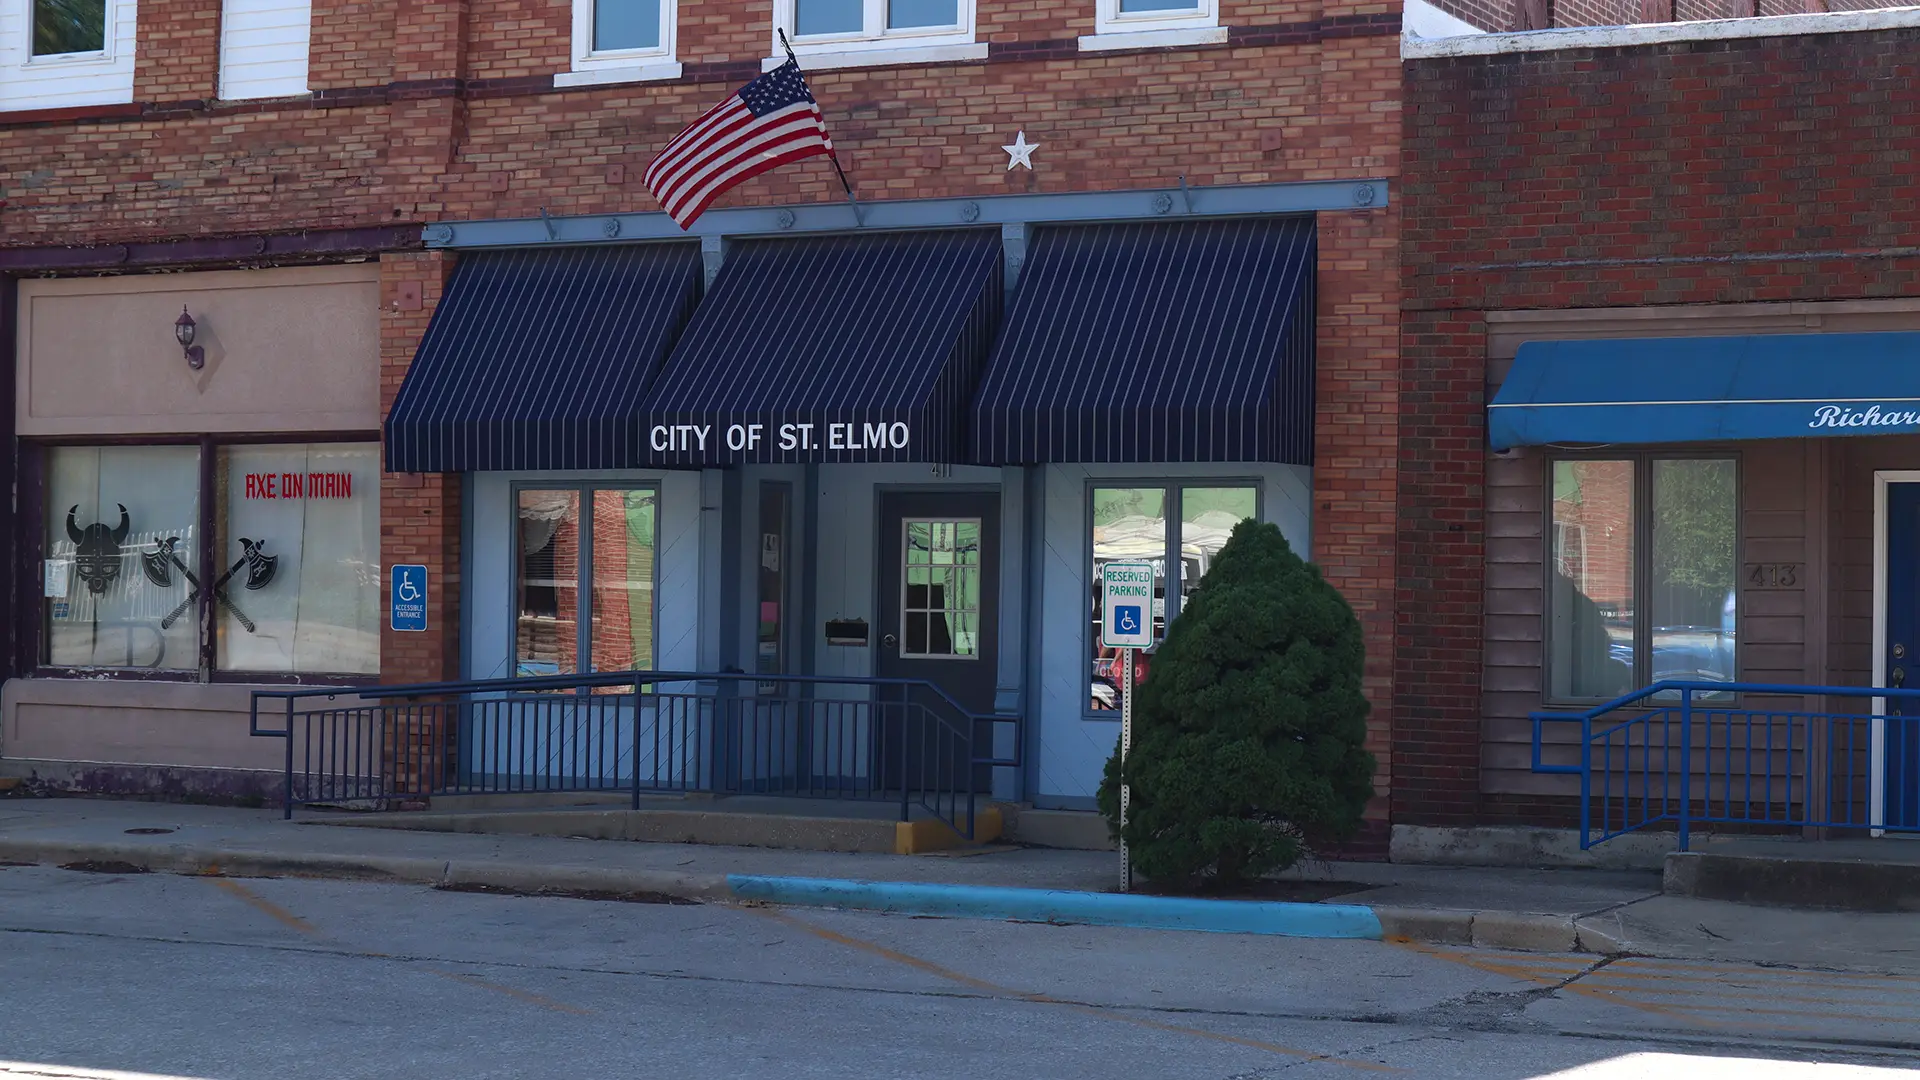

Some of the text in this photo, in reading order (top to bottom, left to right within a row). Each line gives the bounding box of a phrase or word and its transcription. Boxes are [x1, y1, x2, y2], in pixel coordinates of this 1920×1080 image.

[650, 421, 909, 451] CITY OF ST. ELMO
[930, 462, 951, 478] 411
[245, 472, 352, 500] AXE ON MAIN
[1106, 571, 1150, 582] RESERVED
[1749, 563, 1796, 587] 413
[1109, 585, 1147, 596] PARKING
[1100, 666, 1142, 677] CLOD
